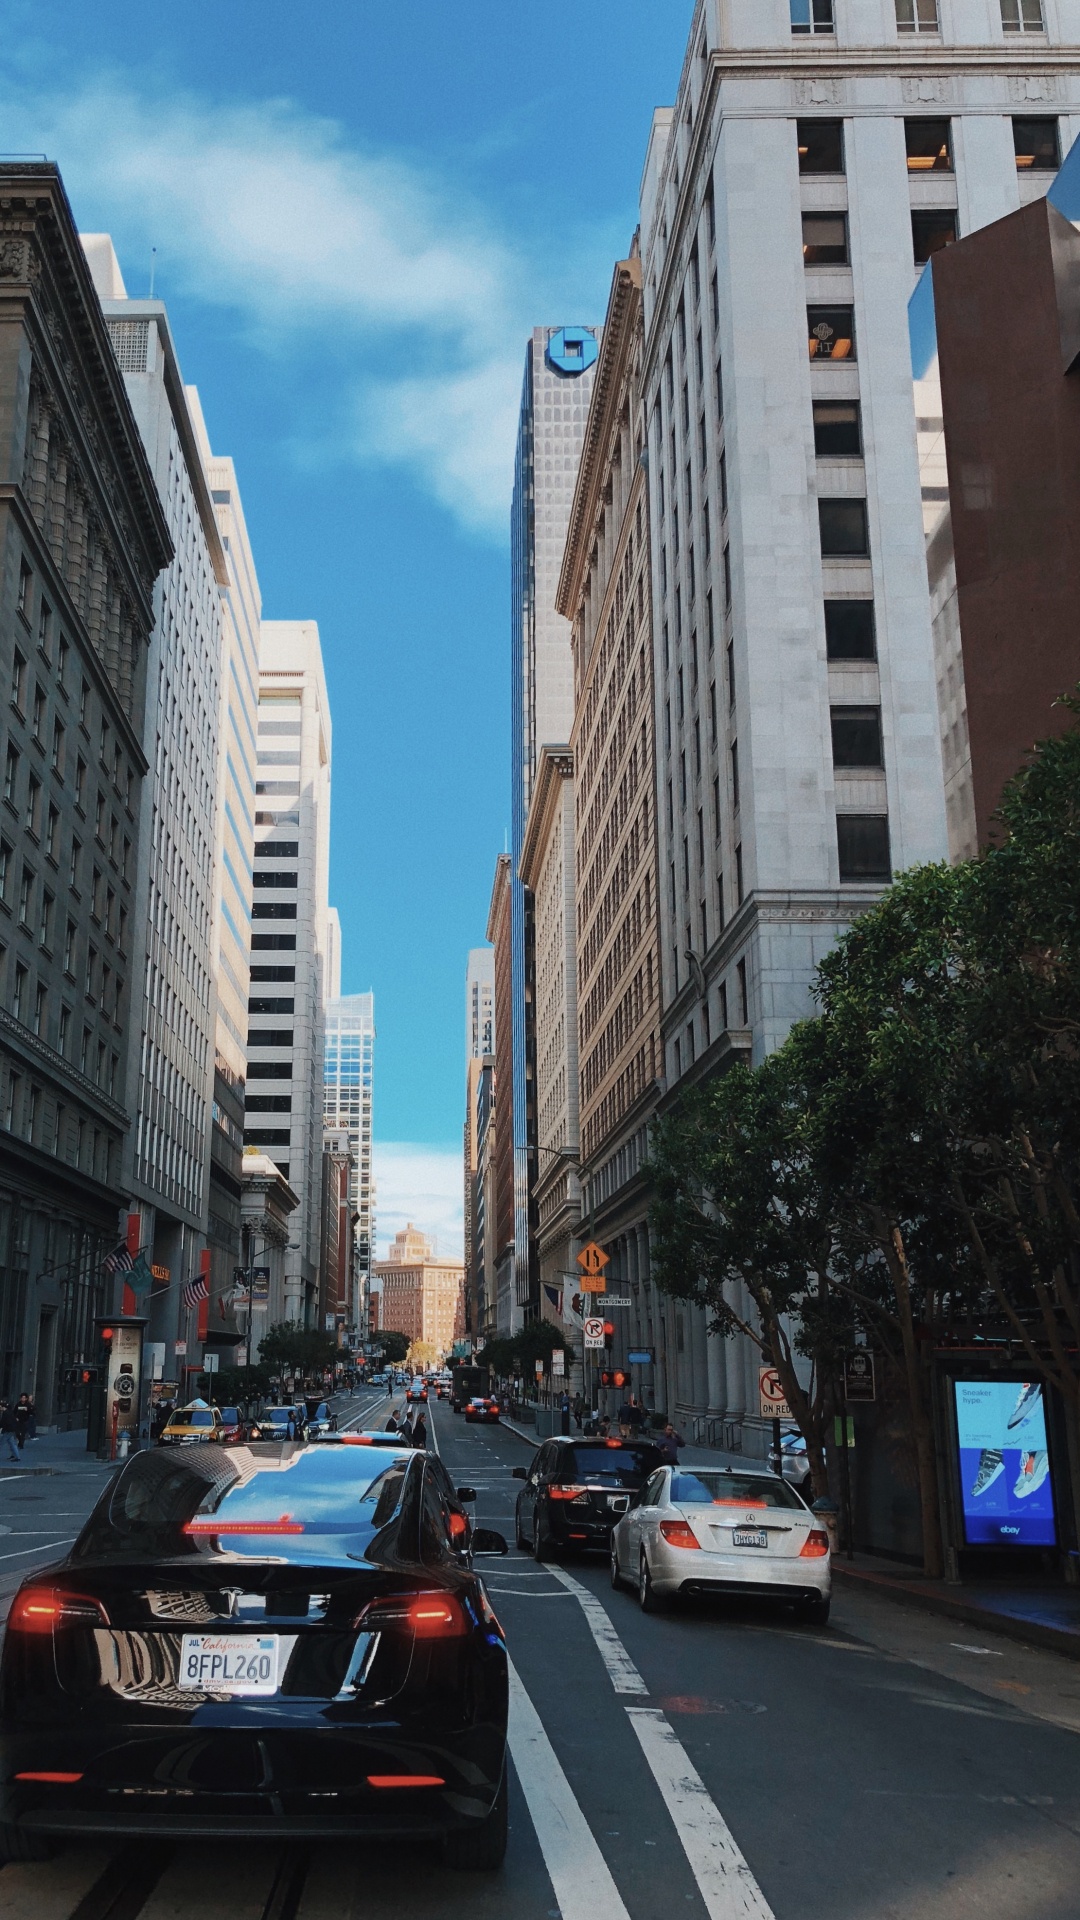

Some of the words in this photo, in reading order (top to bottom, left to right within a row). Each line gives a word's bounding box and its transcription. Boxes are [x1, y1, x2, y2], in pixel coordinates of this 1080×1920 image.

[962, 1389, 991, 1397] Sneaker
[776, 1405, 791, 1414] RED
[1000, 1525, 1020, 1535] ebay
[735, 1534, 765, 1545] 7HYG138
[189, 1639, 200, 1647] JUL
[202, 1637, 254, 1653] California
[187, 1654, 271, 1679] 8FPL260
